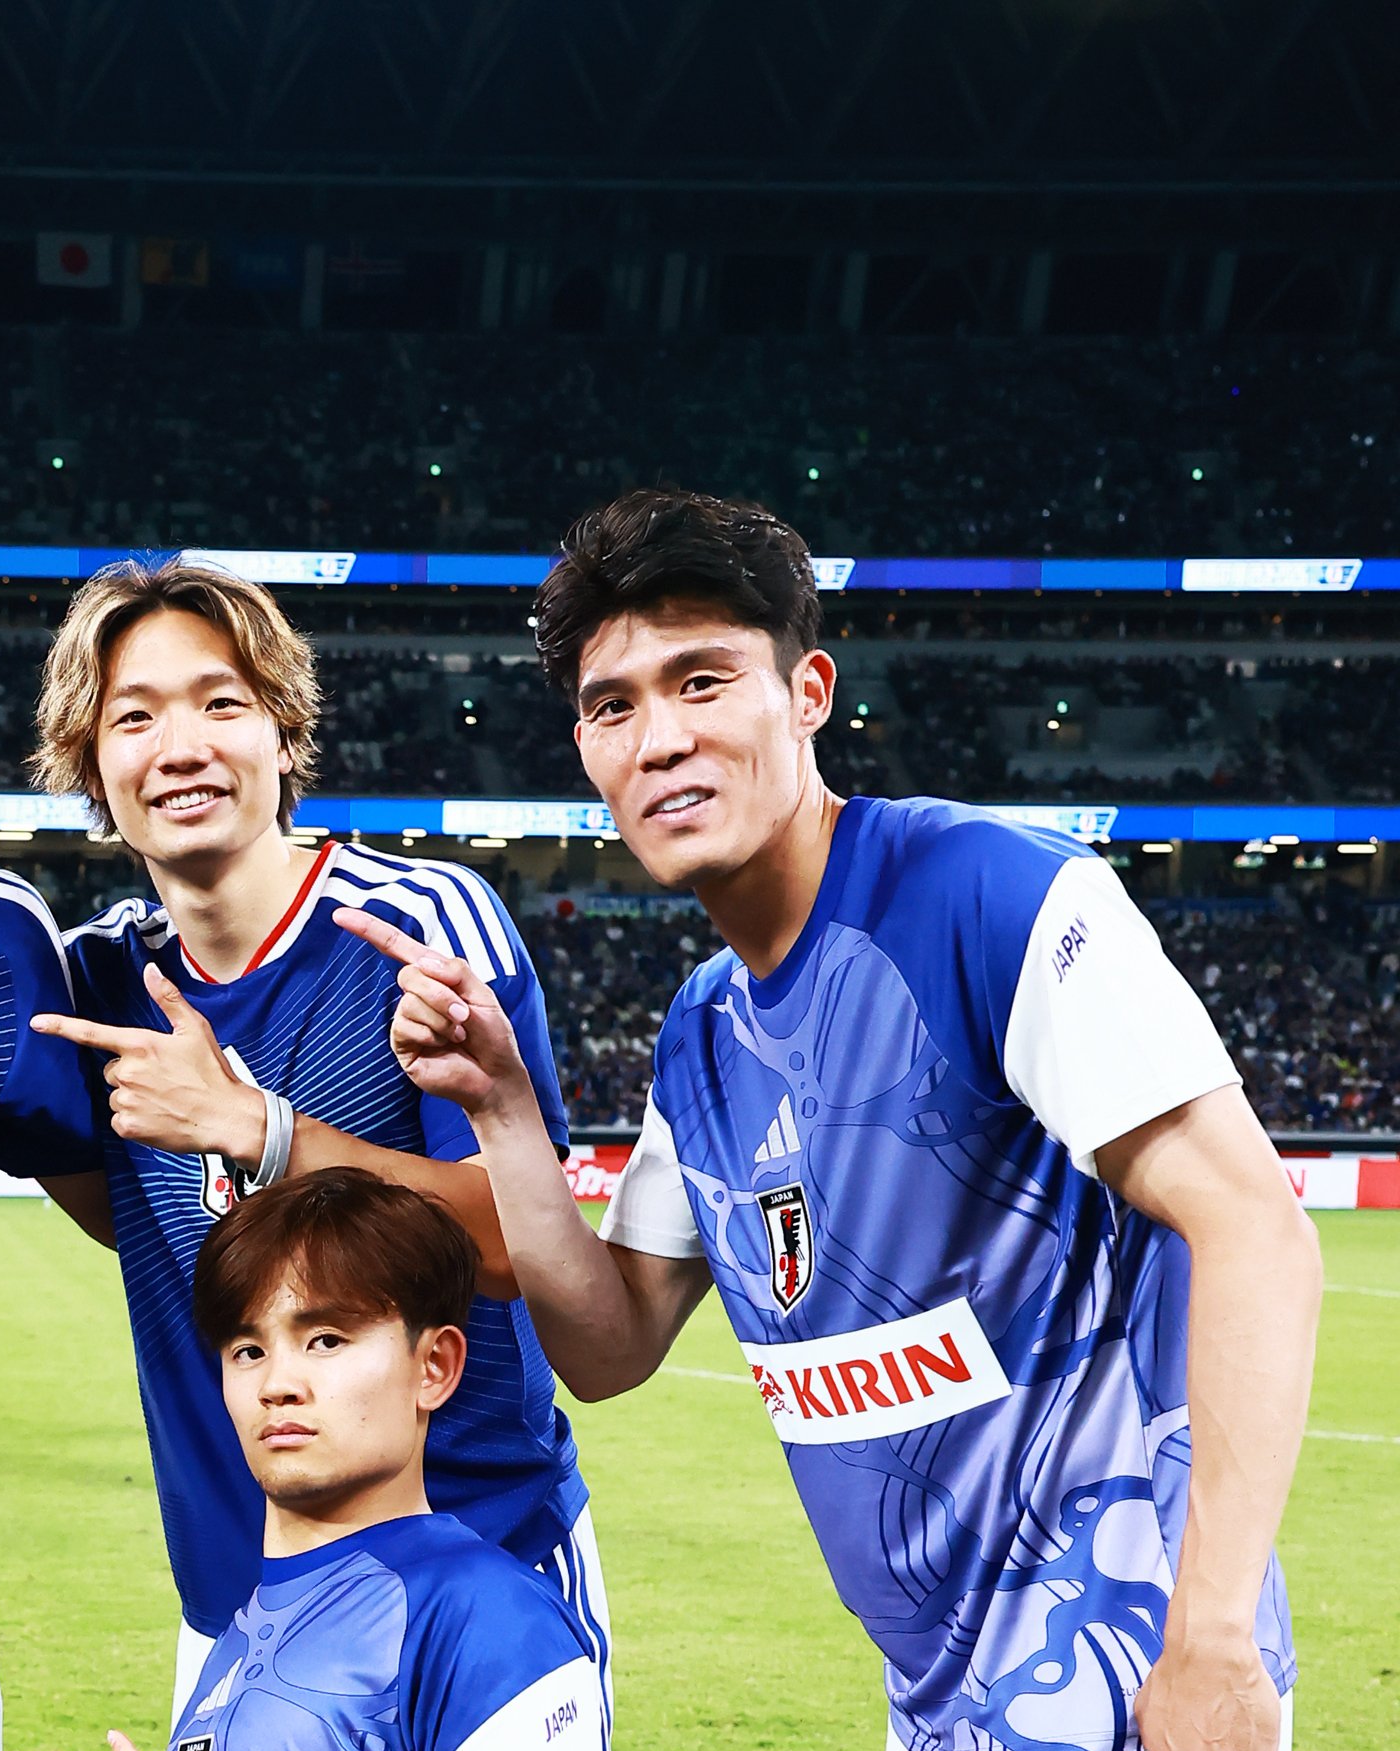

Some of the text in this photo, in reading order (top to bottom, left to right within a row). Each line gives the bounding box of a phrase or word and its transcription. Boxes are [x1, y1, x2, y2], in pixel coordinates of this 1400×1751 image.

[1051, 911, 1090, 985] JAPAN
[770, 1190, 794, 1205] JAPAN
[786, 1332, 974, 1420] KIRIN
[544, 1695, 578, 1743] JAPAN
